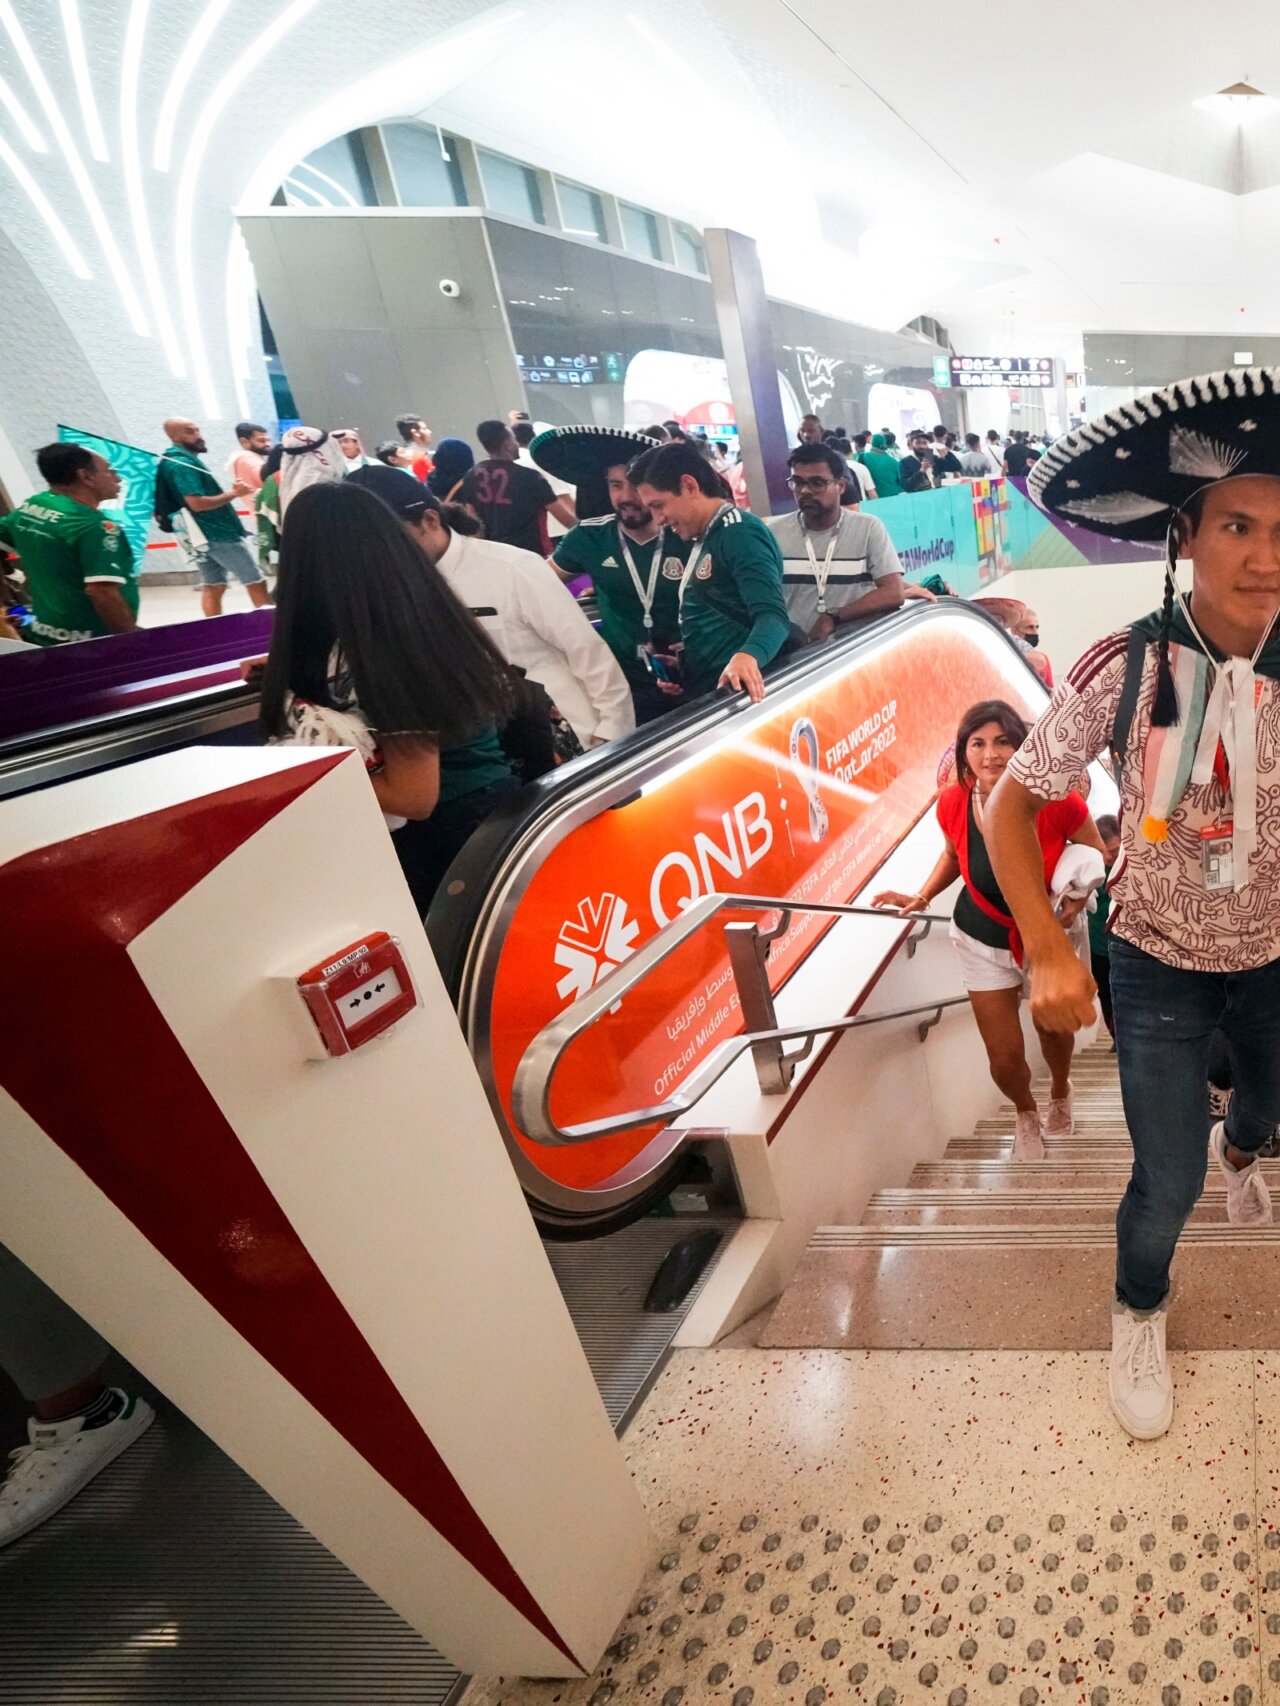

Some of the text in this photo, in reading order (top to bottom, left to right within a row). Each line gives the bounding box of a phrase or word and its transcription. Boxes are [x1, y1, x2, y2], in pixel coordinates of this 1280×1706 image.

[473, 466, 513, 505] 32
[898, 538, 954, 574] FAWorldCup
[825, 699, 897, 770] FIFA WORLD CUP
[650, 791, 774, 929] QNB
[801, 872, 819, 897] FIFA
[654, 1041, 697, 1096] Official
[695, 1006, 731, 1048] Middle
[768, 937, 791, 968] Africa
[832, 878, 843, 893] the
[842, 863, 858, 880] FIFA
[705, 966, 734, 1000] وسط
